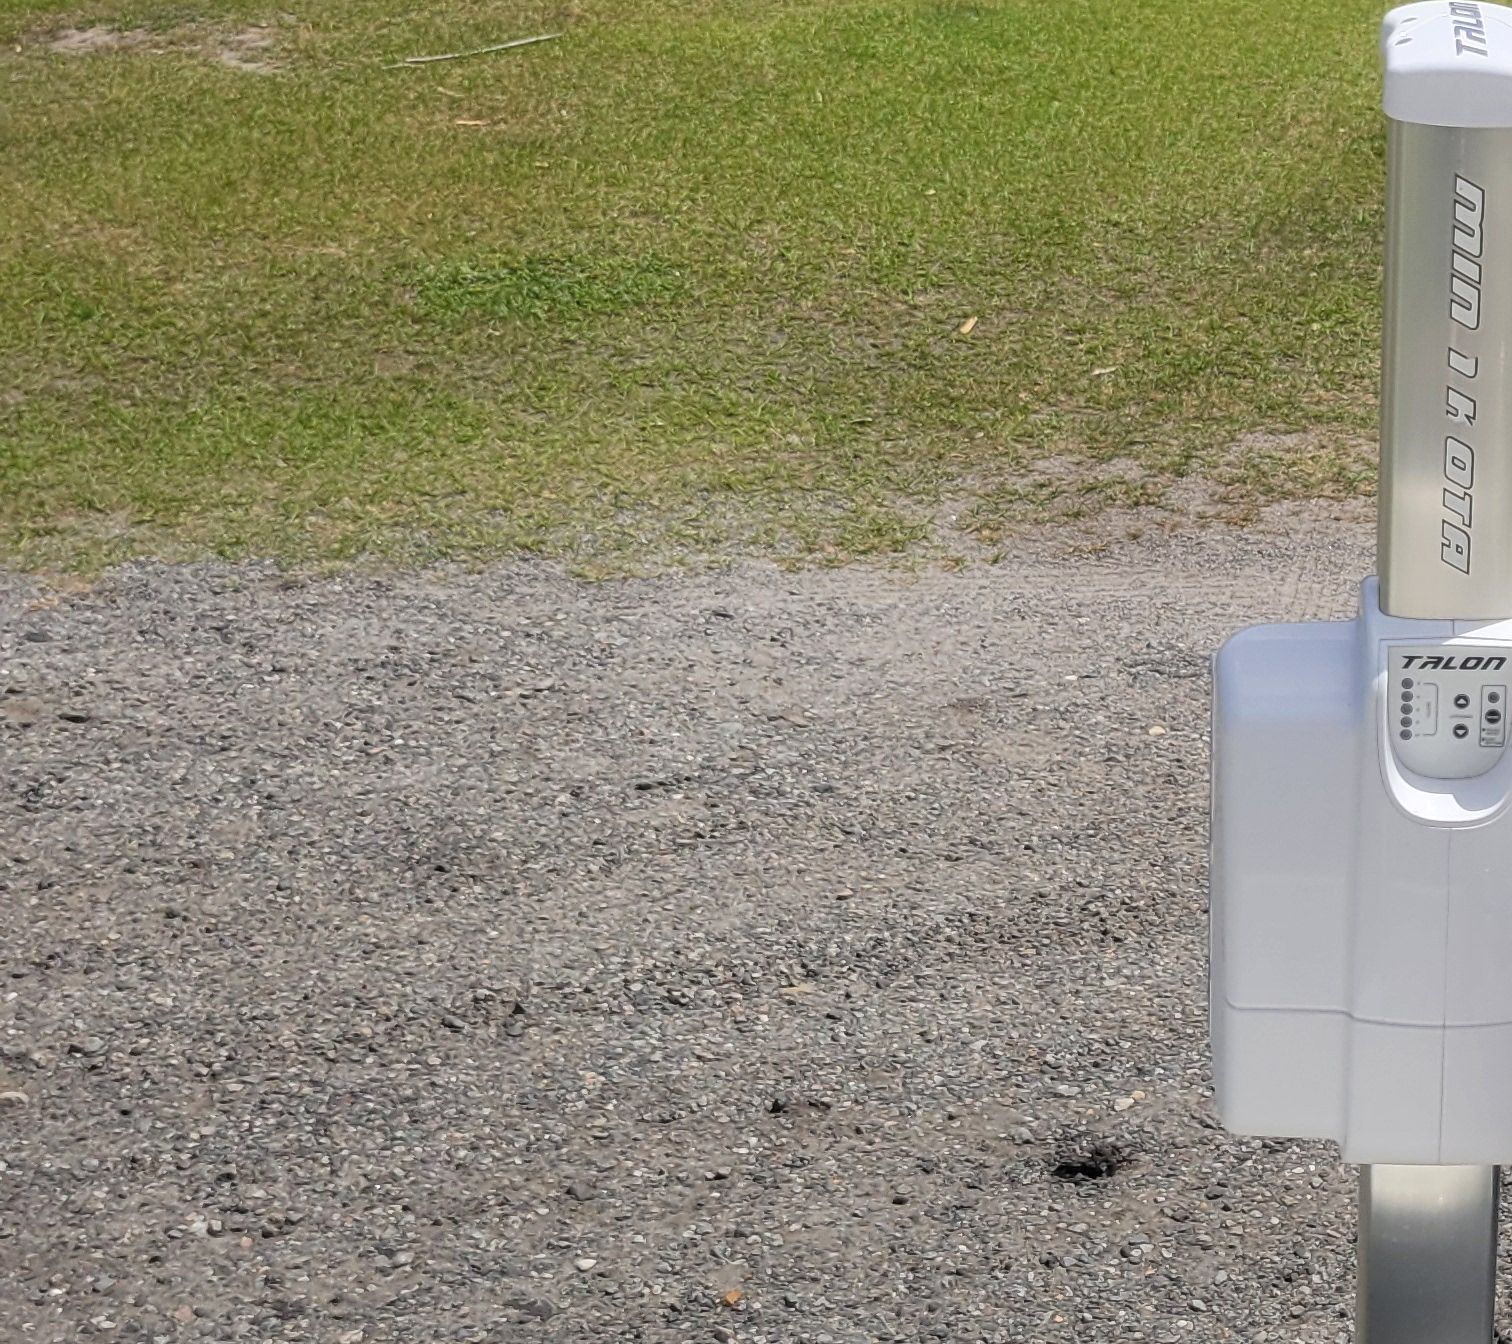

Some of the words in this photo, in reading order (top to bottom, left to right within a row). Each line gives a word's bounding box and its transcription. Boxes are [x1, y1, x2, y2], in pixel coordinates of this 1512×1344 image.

[1449, 2, 1488, 57] TALON
[1441, 385, 1477, 575] KOTA
[1401, 655, 1507, 671] TALON
